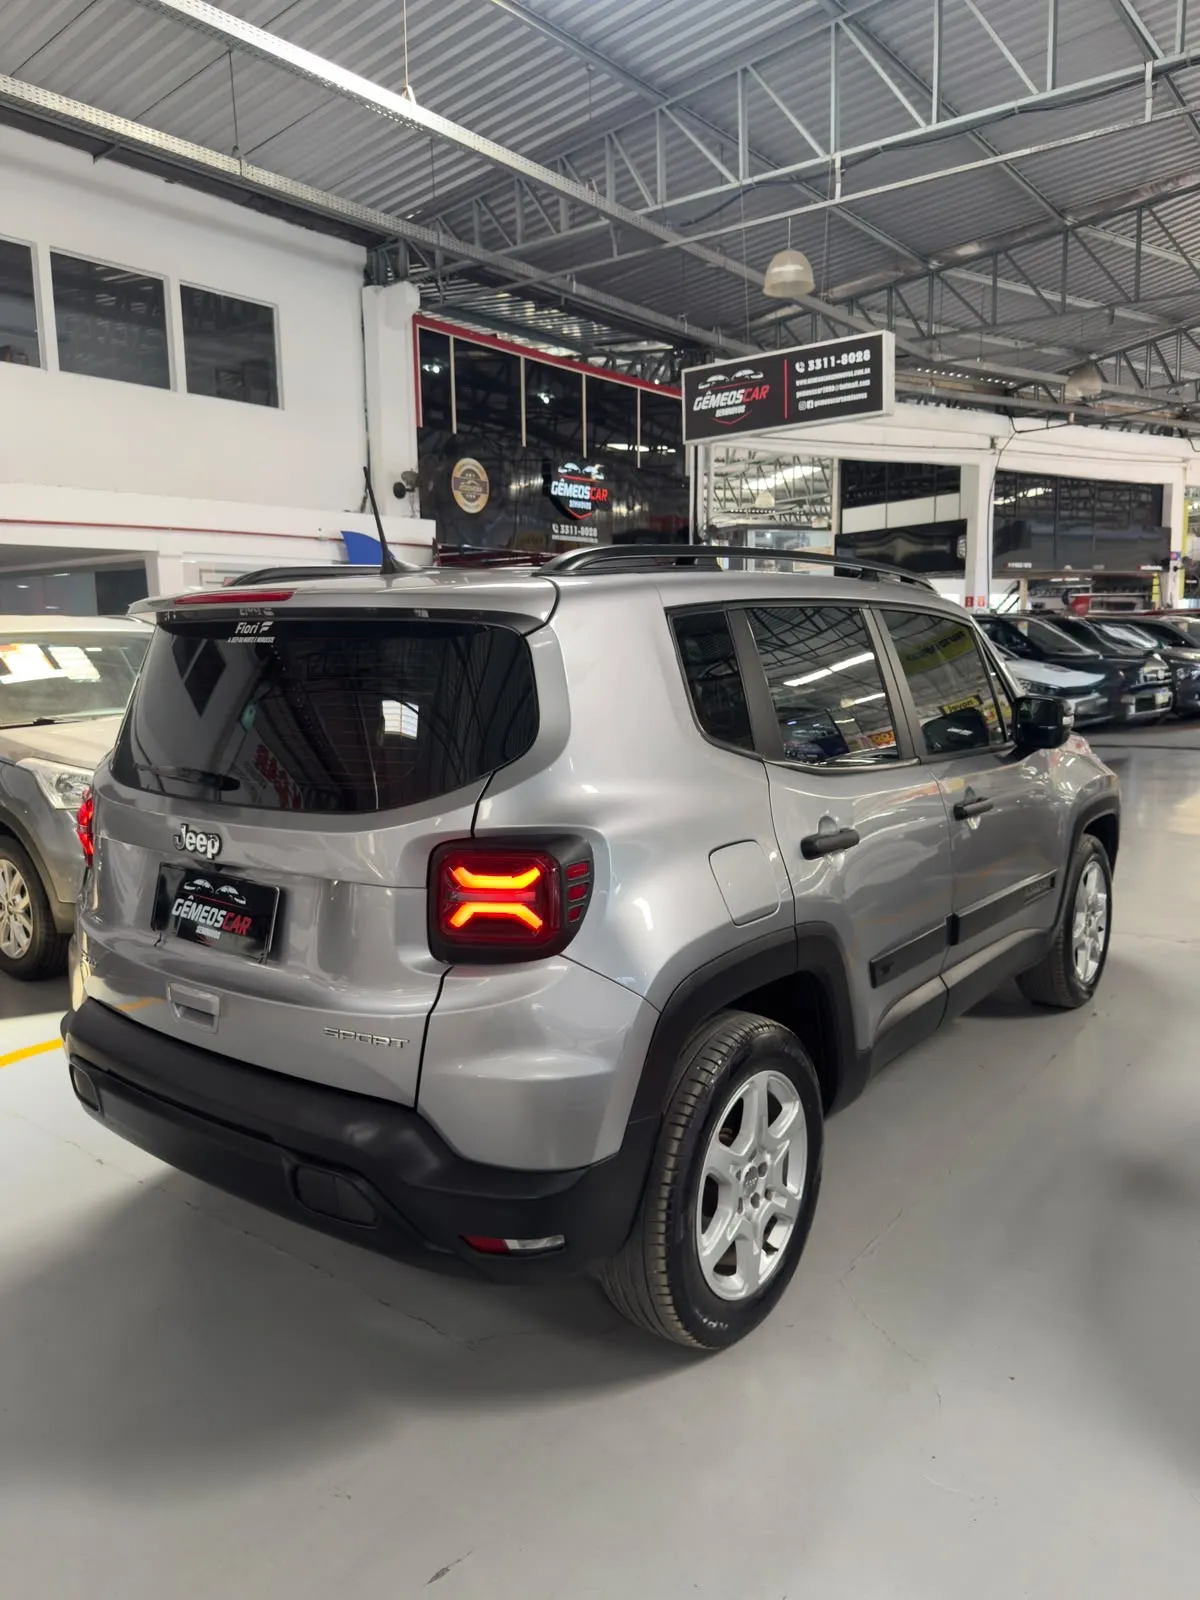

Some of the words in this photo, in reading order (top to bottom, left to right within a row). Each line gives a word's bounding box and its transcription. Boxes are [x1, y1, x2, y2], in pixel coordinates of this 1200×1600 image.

[807, 349, 871, 372] 3311-8028
[550, 478, 609, 501] GÊMEOSCAR
[234, 621, 260, 635] Fiori
[173, 823, 222, 860] Jeep
[171, 894, 253, 937] GÊMEOSCAR
[323, 1026, 410, 1049] SPORT
